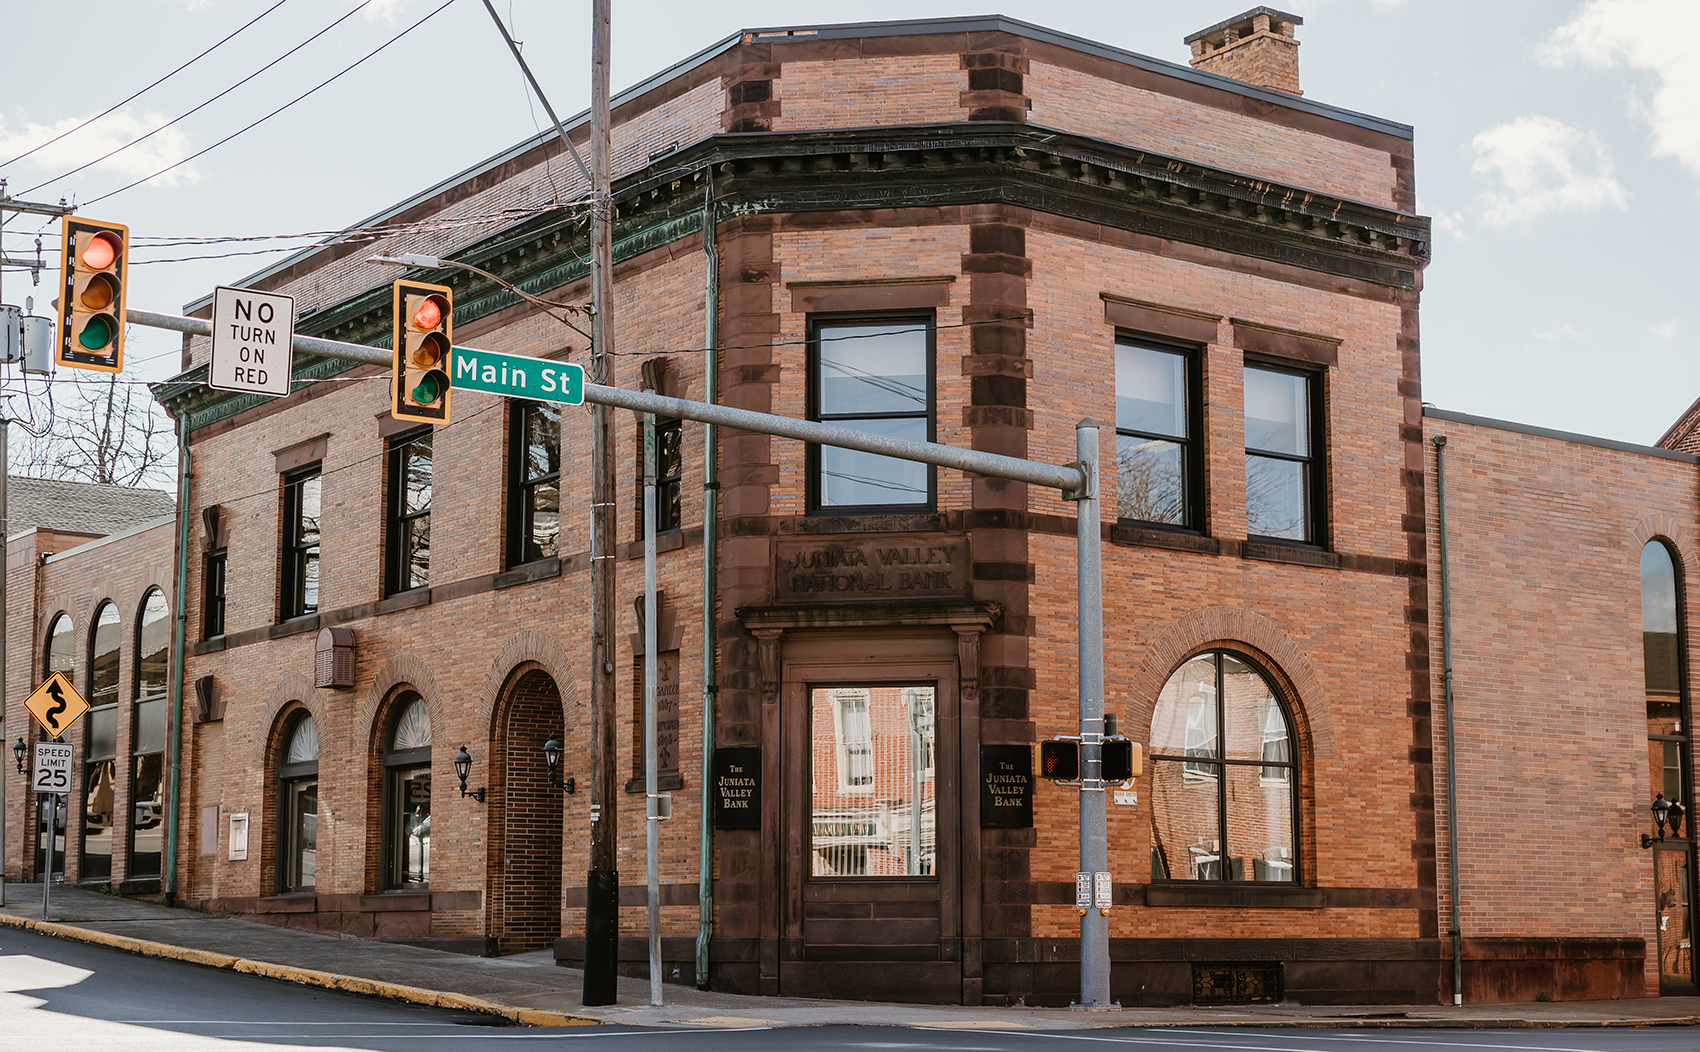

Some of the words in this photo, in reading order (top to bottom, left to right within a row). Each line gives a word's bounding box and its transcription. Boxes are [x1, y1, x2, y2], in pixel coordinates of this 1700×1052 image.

[235, 298, 275, 324] NO
[230, 324, 276, 346] TURN
[240, 346, 265, 365] ON
[234, 366, 268, 385] RED
[457, 355, 527, 388] Main
[541, 368, 570, 395] St
[786, 549, 869, 568] JUNIATA
[876, 547, 957, 566] VALLEY
[791, 573, 892, 593] NATIONAL
[899, 571, 953, 590] BANK
[38, 748, 71, 758] SPEED
[41, 758, 66, 767] LIMIT
[37, 768, 68, 788] 25
[718, 776, 756, 787] JUNIATA
[985, 772, 1028, 784] JUNIATA
[720, 787, 753, 798] VALLEY
[988, 784, 1025, 795] VALLEY
[723, 798, 749, 809] BANK
[994, 796, 1023, 807] BANK
